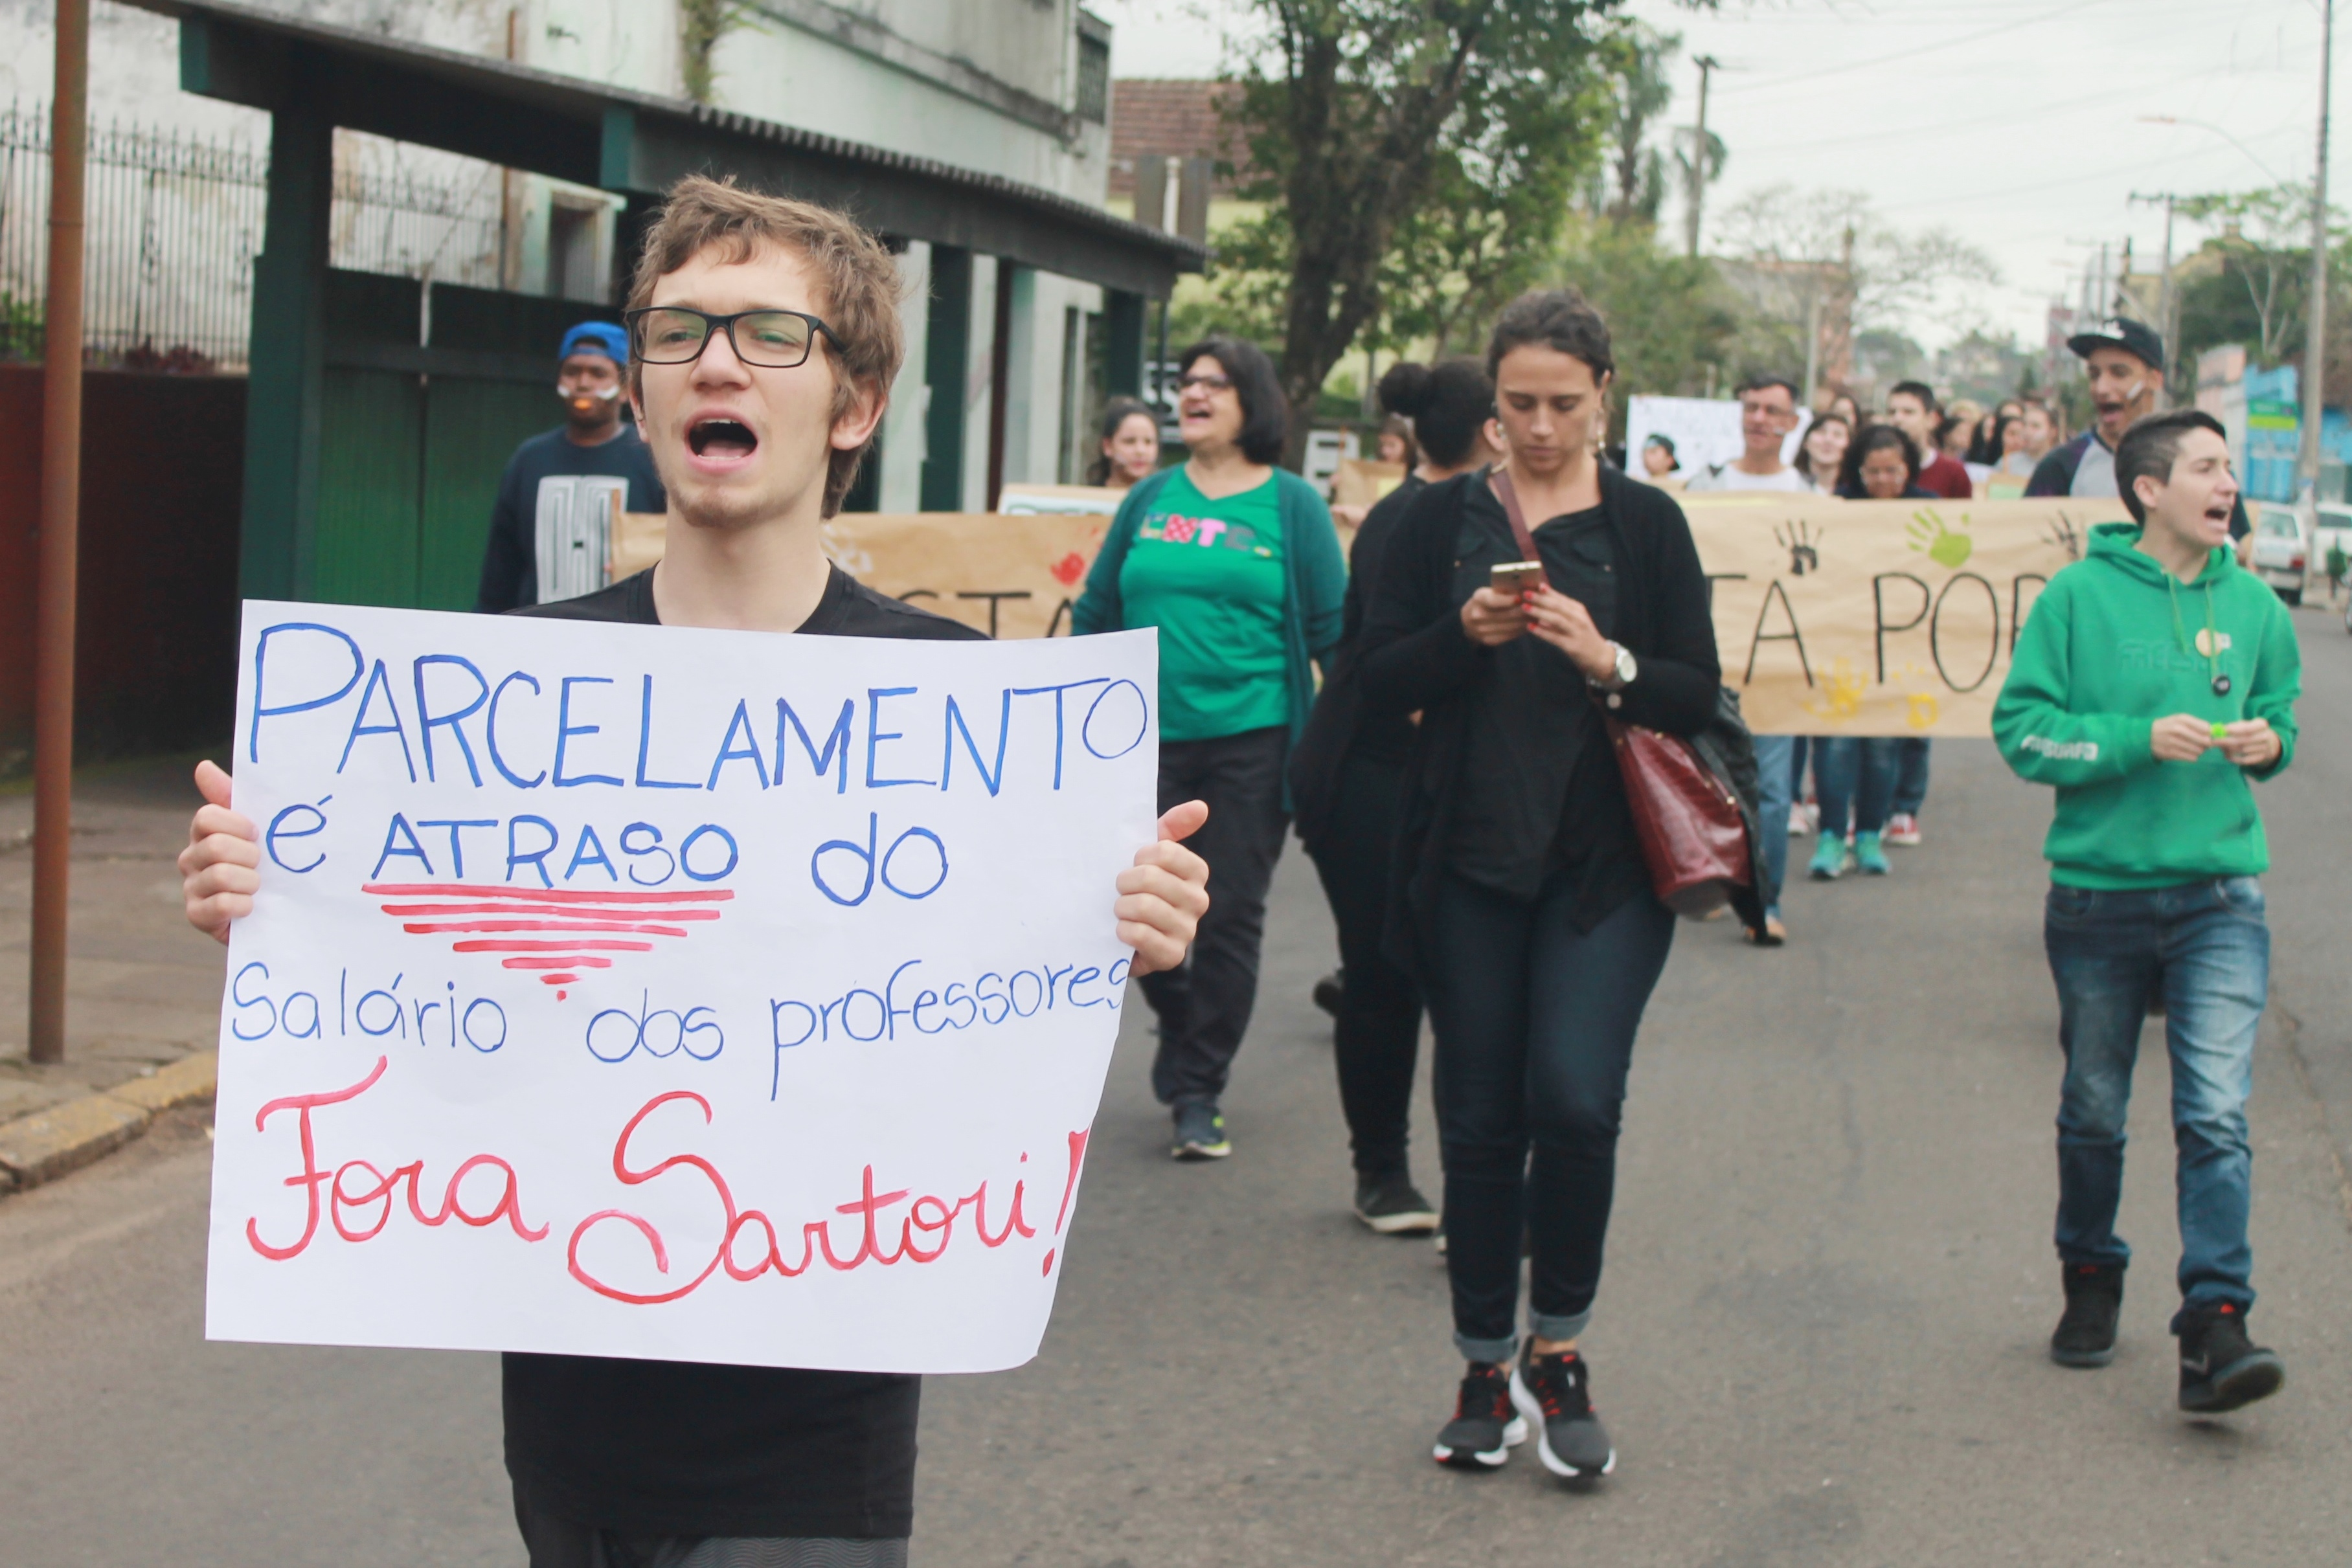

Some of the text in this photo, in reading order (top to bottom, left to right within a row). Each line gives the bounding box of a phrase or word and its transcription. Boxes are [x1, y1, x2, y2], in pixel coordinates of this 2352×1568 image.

[249, 622, 1148, 796] PARCELAMENTO
[370, 812, 740, 889] ATRASO
[811, 811, 950, 908] do
[232, 958, 1131, 1102] Salário dos professores
[246, 1055, 1090, 1305] Fora Sartori!
